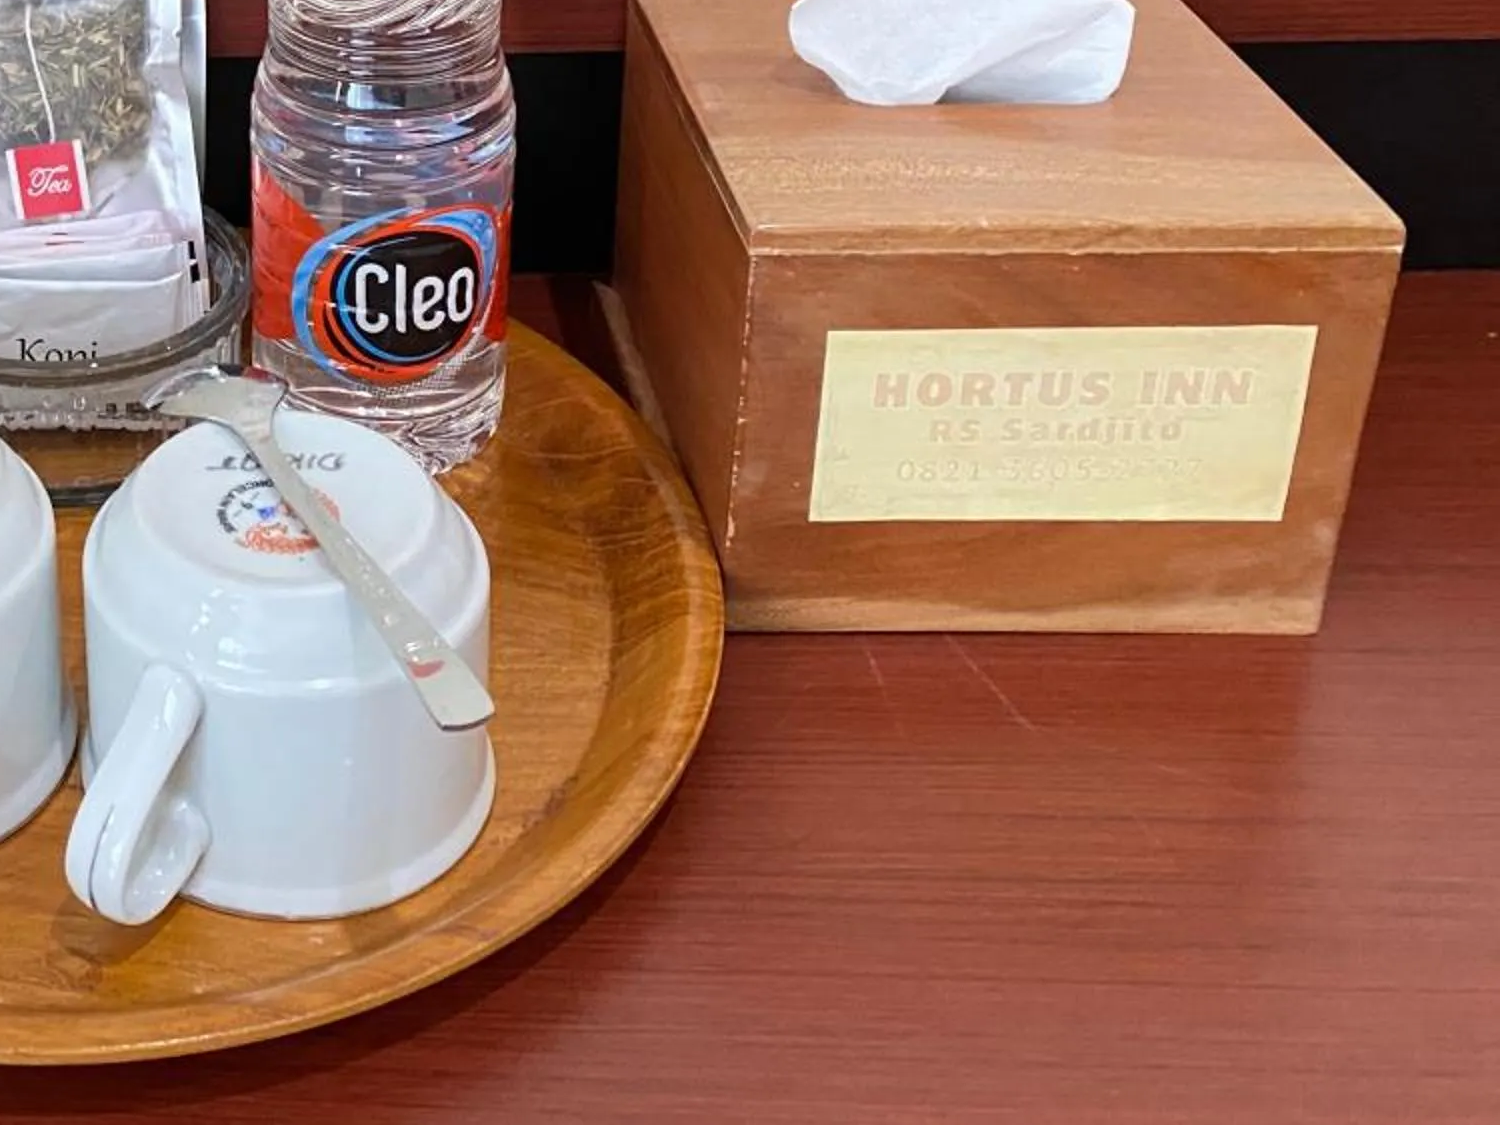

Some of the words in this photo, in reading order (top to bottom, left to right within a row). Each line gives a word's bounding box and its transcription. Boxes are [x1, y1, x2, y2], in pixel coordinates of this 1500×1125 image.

[28, 164, 72, 197] Tea
[354, 263, 476, 335] Cleo
[873, 371, 1112, 409] HORTUS
[1139, 369, 1254, 407] INN
[929, 419, 982, 443] RS
[1001, 416, 1183, 445] Sardjito
